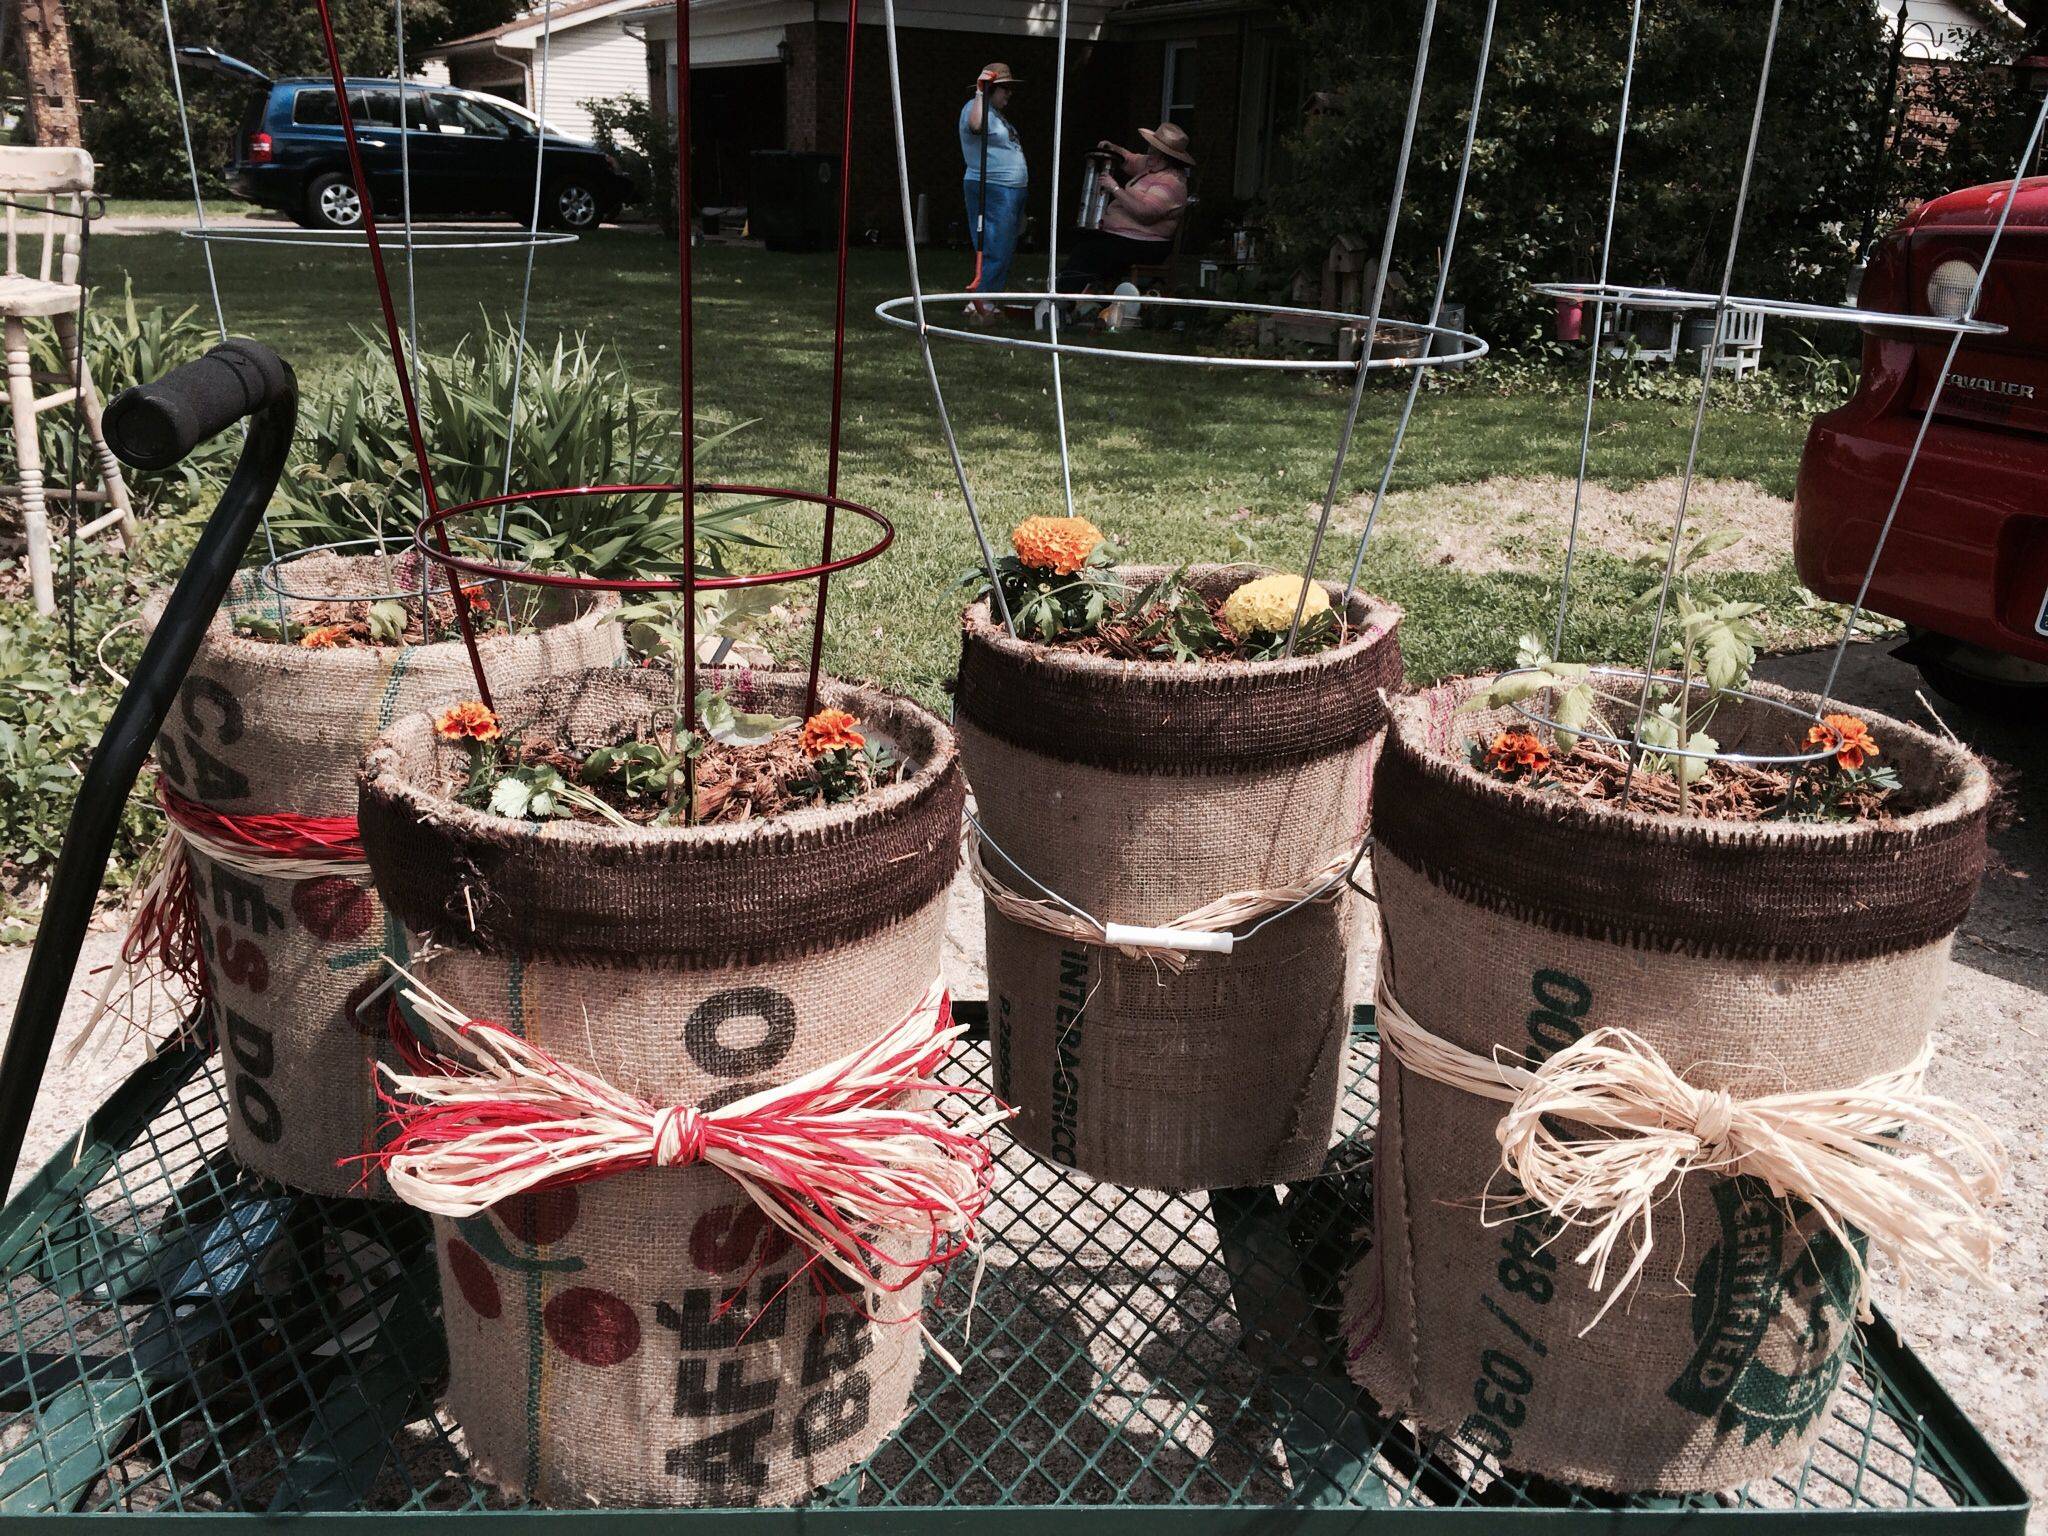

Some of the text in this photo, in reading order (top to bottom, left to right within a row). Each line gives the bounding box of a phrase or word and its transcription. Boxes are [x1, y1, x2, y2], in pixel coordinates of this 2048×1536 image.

[181, 675, 285, 994] CAÉS
[227, 1007, 282, 1145] DO
[652, 1203, 792, 1500] AFÉS
[1699, 1199, 1772, 1388] CERTIFIED
